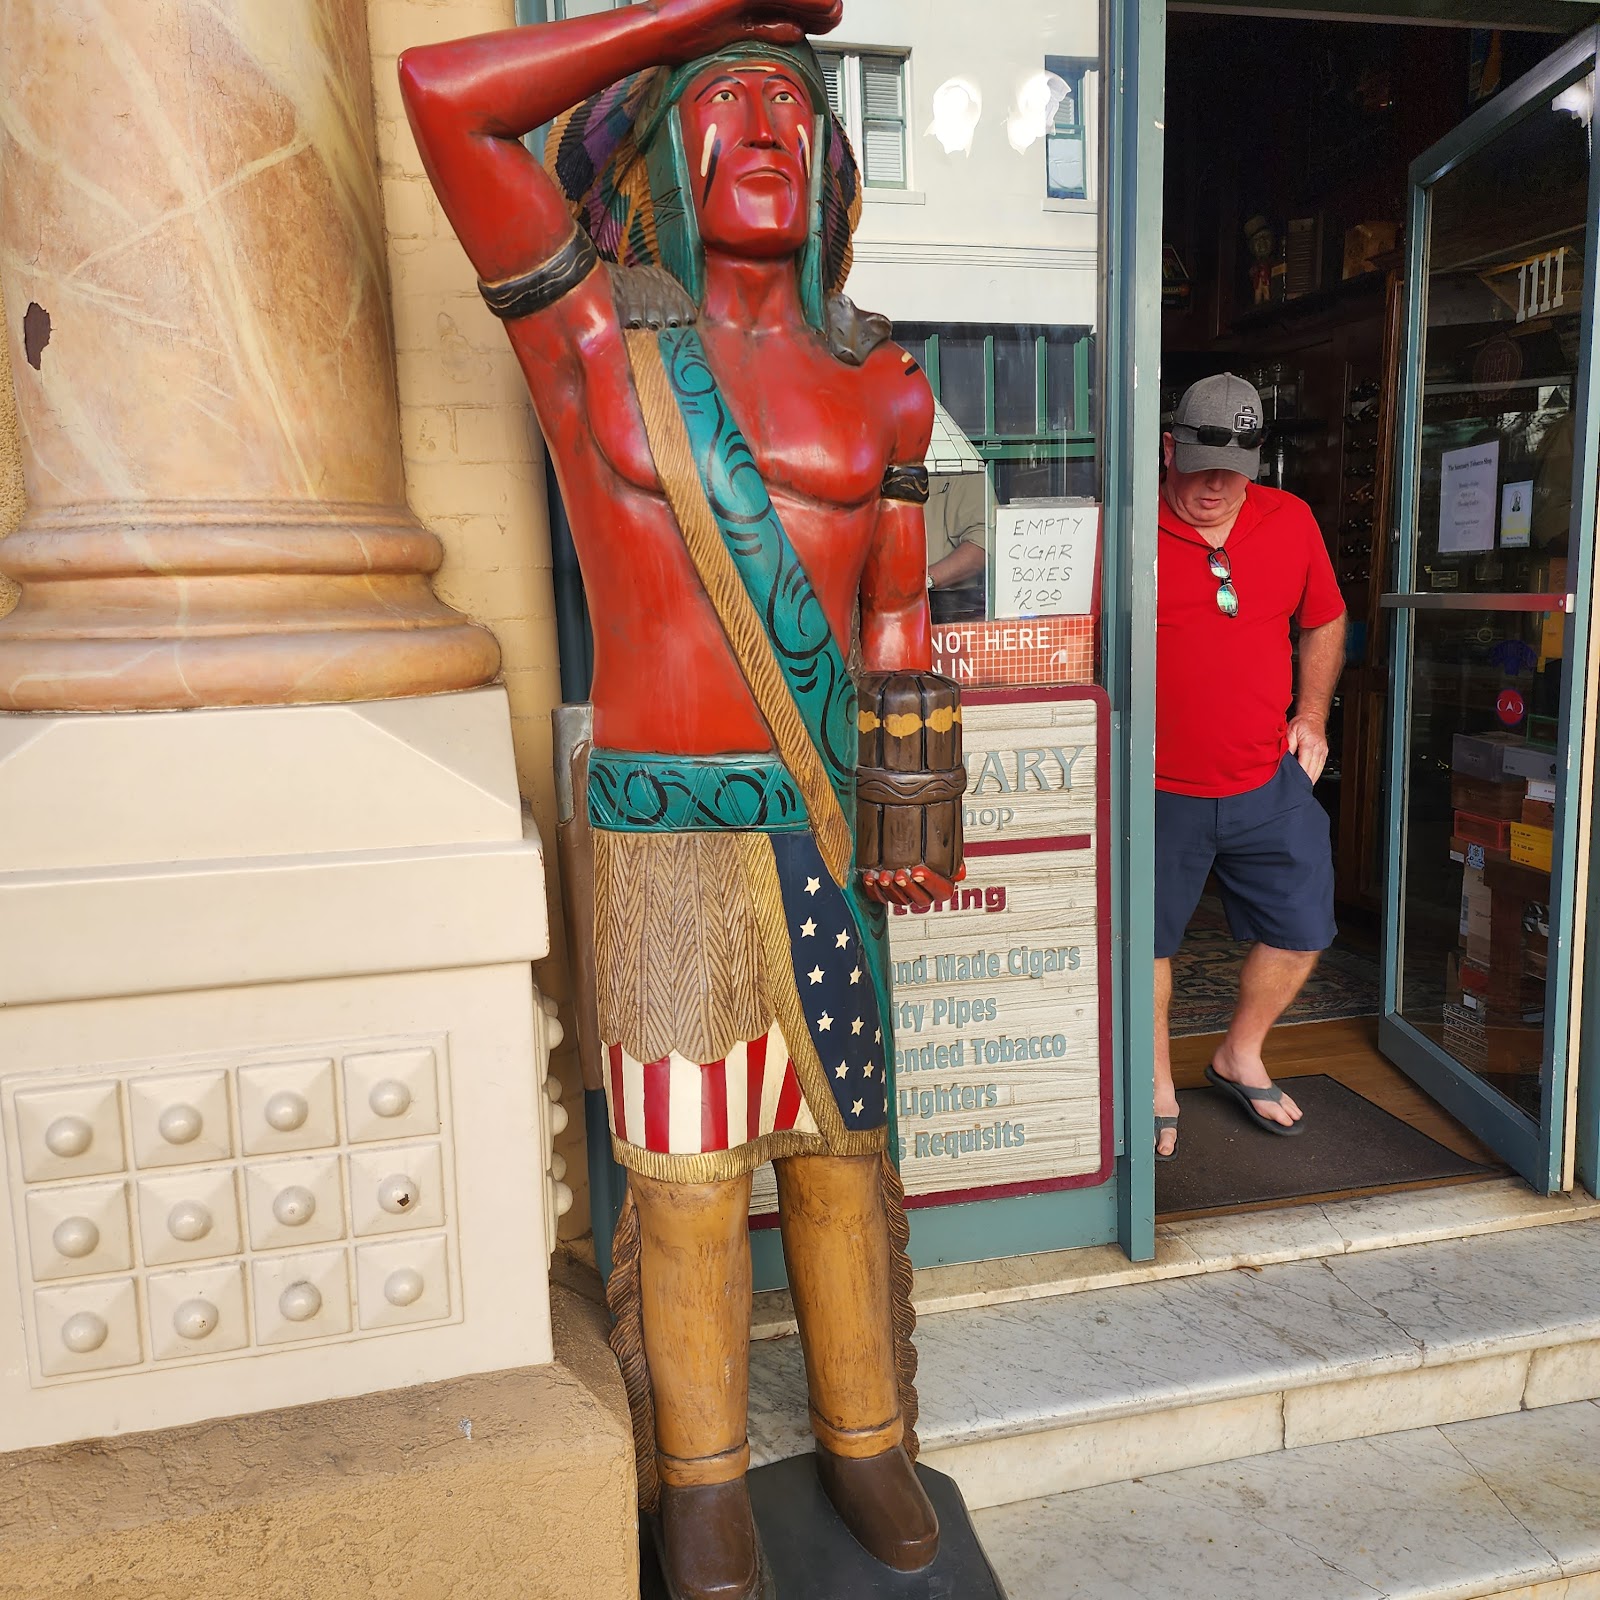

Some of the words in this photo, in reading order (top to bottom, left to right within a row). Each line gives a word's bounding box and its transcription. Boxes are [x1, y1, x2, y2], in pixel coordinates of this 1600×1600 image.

[1516, 246, 1565, 324] 1111
[1013, 517, 1083, 535] EMPTY
[1009, 544, 1073, 560] CIGAR
[1012, 567, 1072, 582] BOXES
[984, 627, 1051, 652] HERE
[951, 657, 974, 679] IN
[935, 949, 1000, 983] Made
[1008, 945, 1081, 979] Cigars
[933, 996, 997, 1029] Pipes
[971, 1033, 1067, 1066] Tobacco
[900, 1082, 998, 1119] Lighters
[915, 1120, 1025, 1159] Requisits
